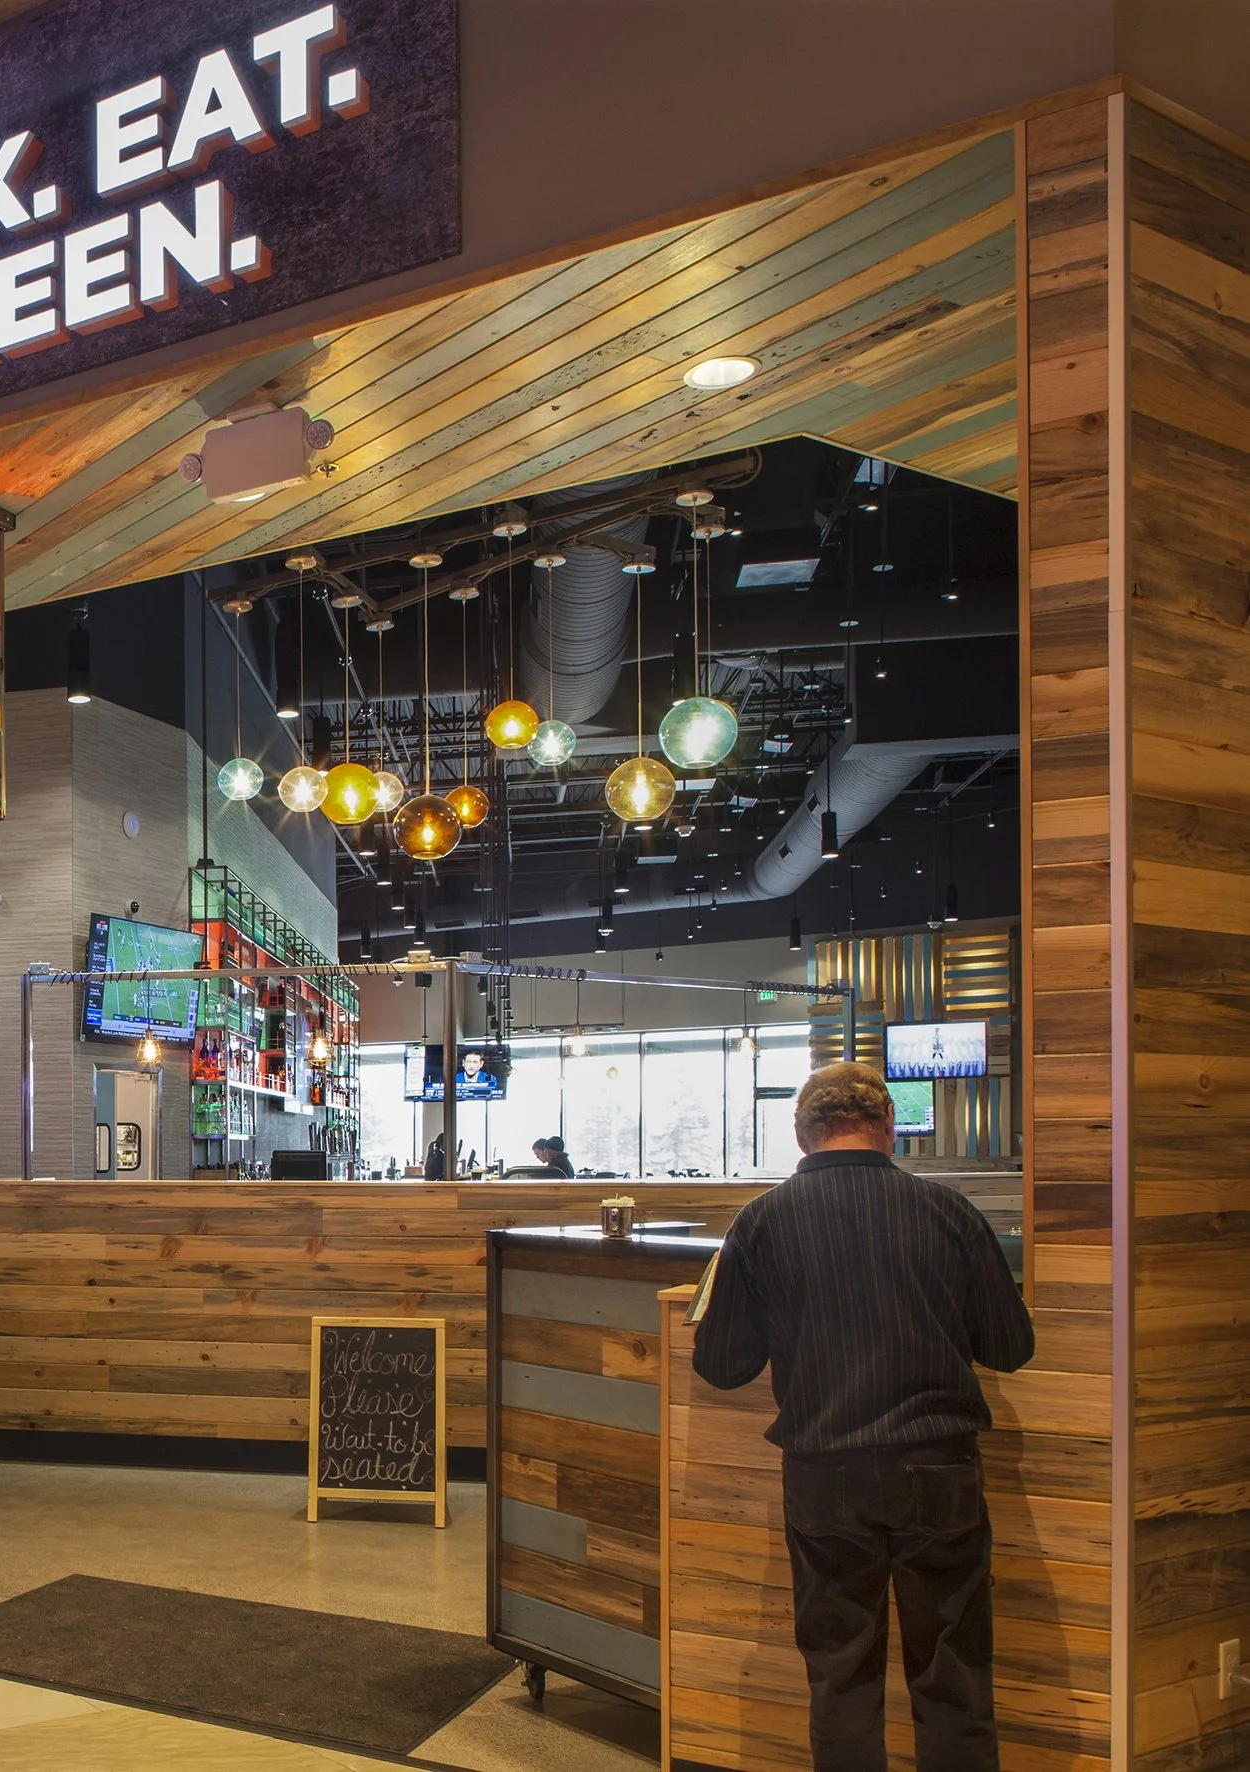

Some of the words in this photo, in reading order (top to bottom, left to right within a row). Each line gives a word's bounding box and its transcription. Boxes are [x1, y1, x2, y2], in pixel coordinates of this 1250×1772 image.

[96, 4, 357, 195] EAT.
[324, 1330, 434, 1376] Welcome
[321, 1372, 423, 1418] Please
[321, 1419, 377, 1451] Wait
[384, 1420, 407, 1454] to
